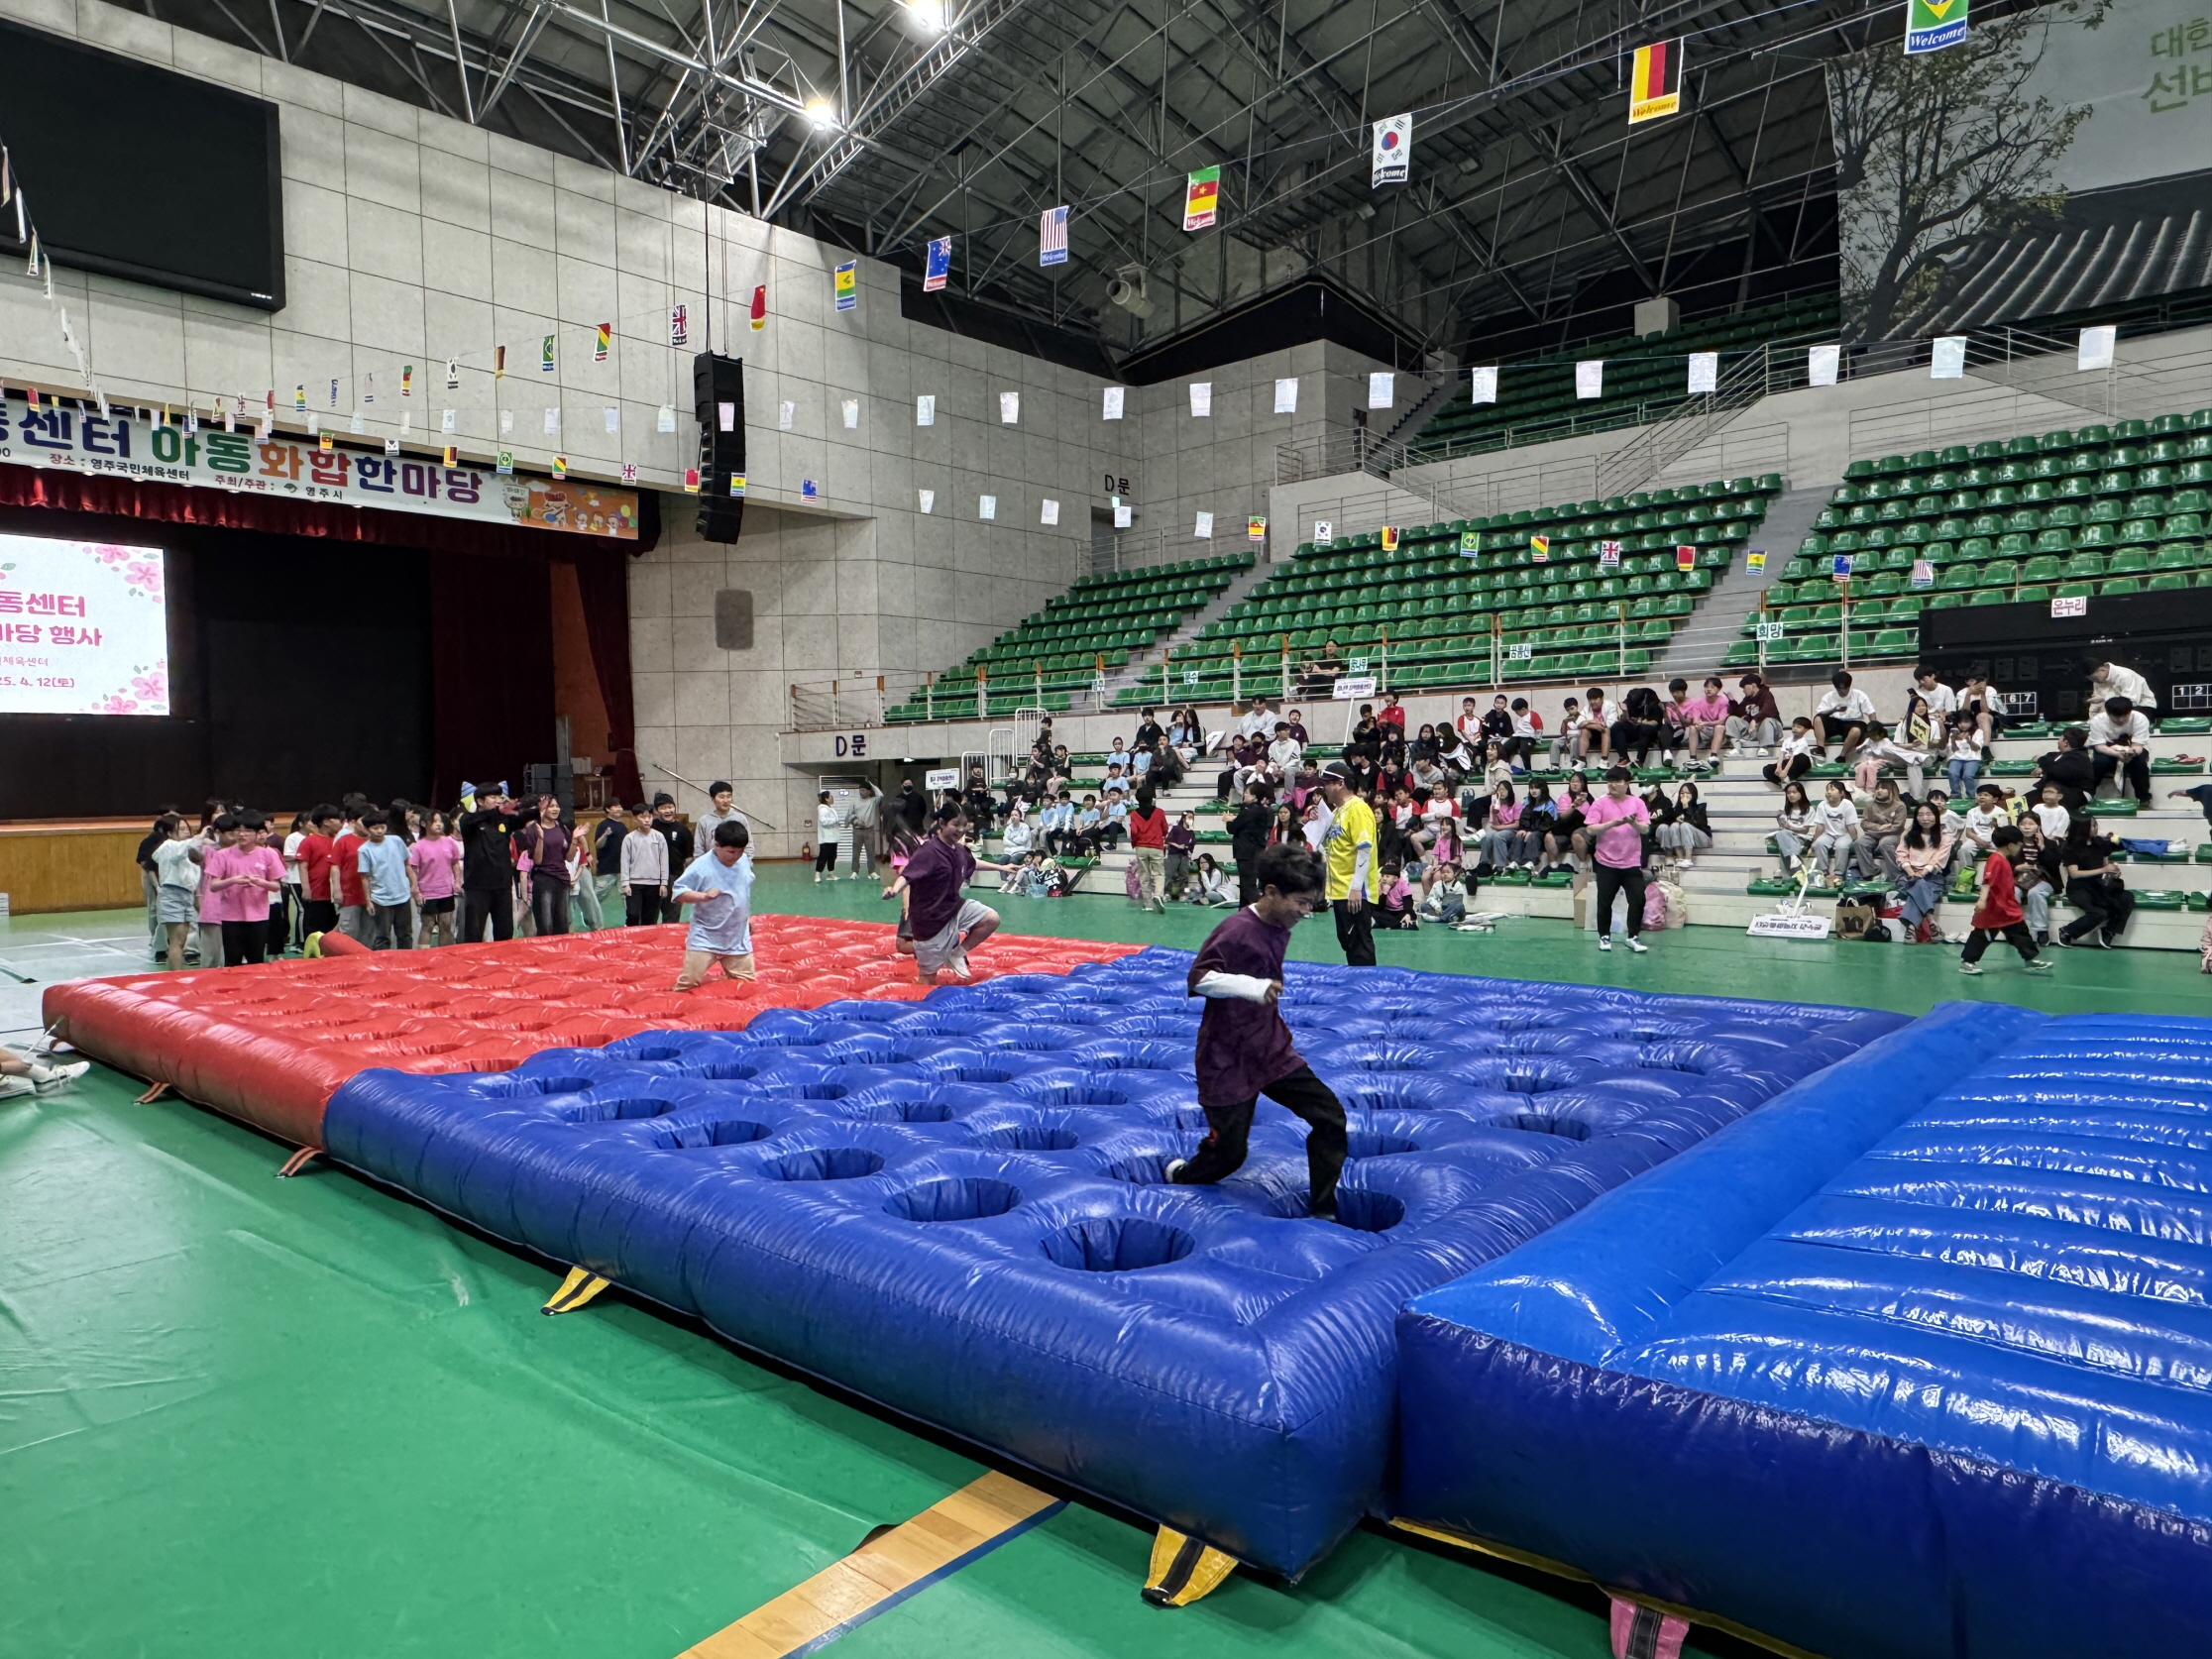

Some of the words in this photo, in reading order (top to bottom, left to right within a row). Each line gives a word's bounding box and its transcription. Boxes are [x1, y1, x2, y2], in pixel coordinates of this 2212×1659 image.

[1911, 27, 1965, 47] Welcome
[1632, 101, 1677, 118] Welcome
[0, 401, 132, 459] 센터
[50, 453, 75, 466] 장소
[90, 458, 190, 481] 영주국민체육센터
[215, 474, 267, 491] 주최/주관
[2053, 597, 2085, 615] 온누리
[50, 625, 102, 646] 행사
[1757, 623, 1783, 639] 희망
[0, 656, 49, 667] 체육센터
[2009, 694, 2017, 703] 6
[2025, 694, 2032, 703] 7
[2178, 687, 2184, 696] 1
[2195, 686, 2203, 695] 2
